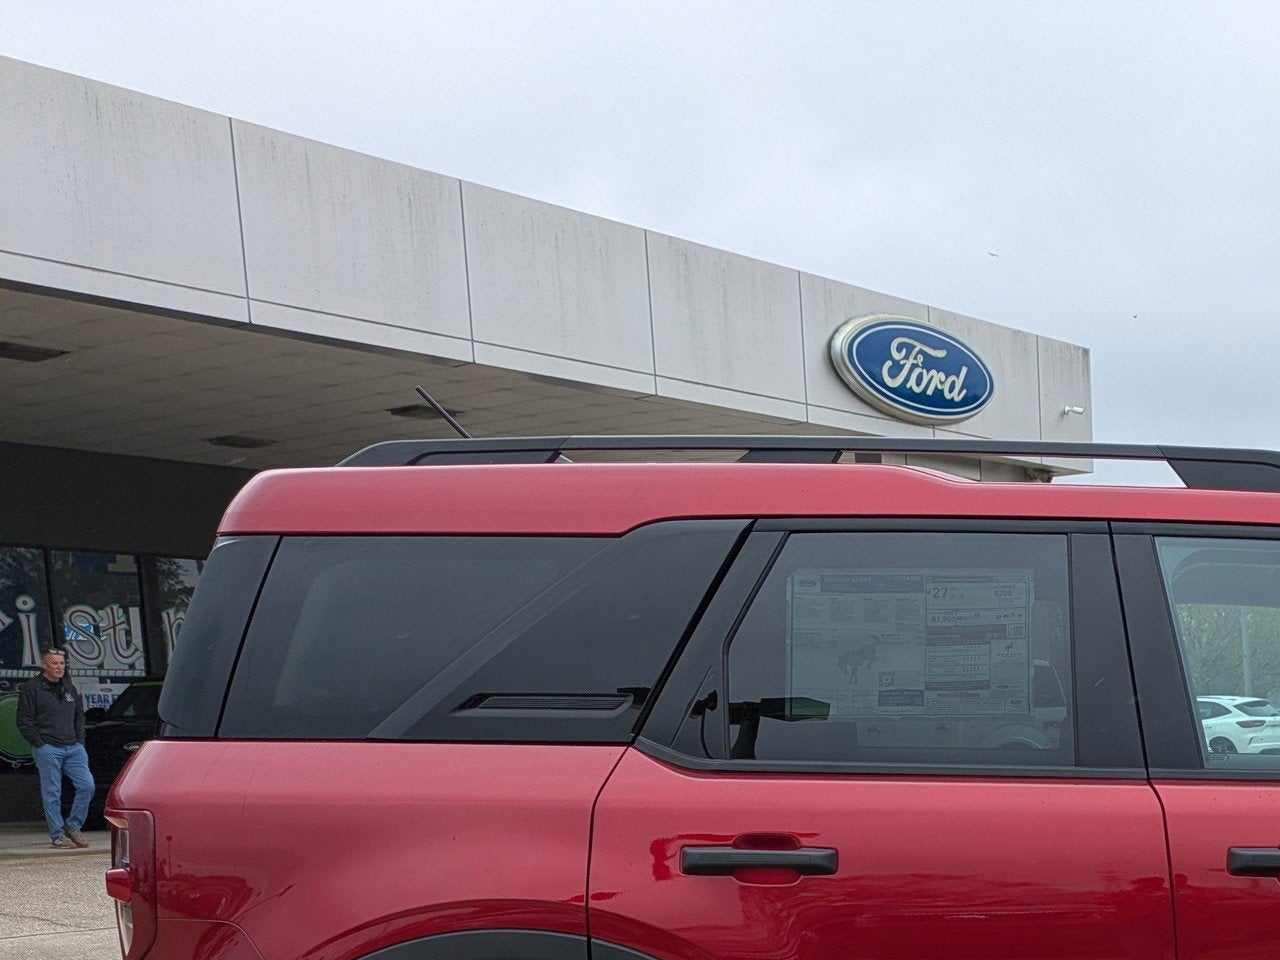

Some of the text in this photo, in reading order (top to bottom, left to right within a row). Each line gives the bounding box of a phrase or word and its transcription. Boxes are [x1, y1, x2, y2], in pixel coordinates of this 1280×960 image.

[882, 336, 968, 402] Ford
[932, 587, 948, 599] 27
[84, 693, 110, 704] YEAR
